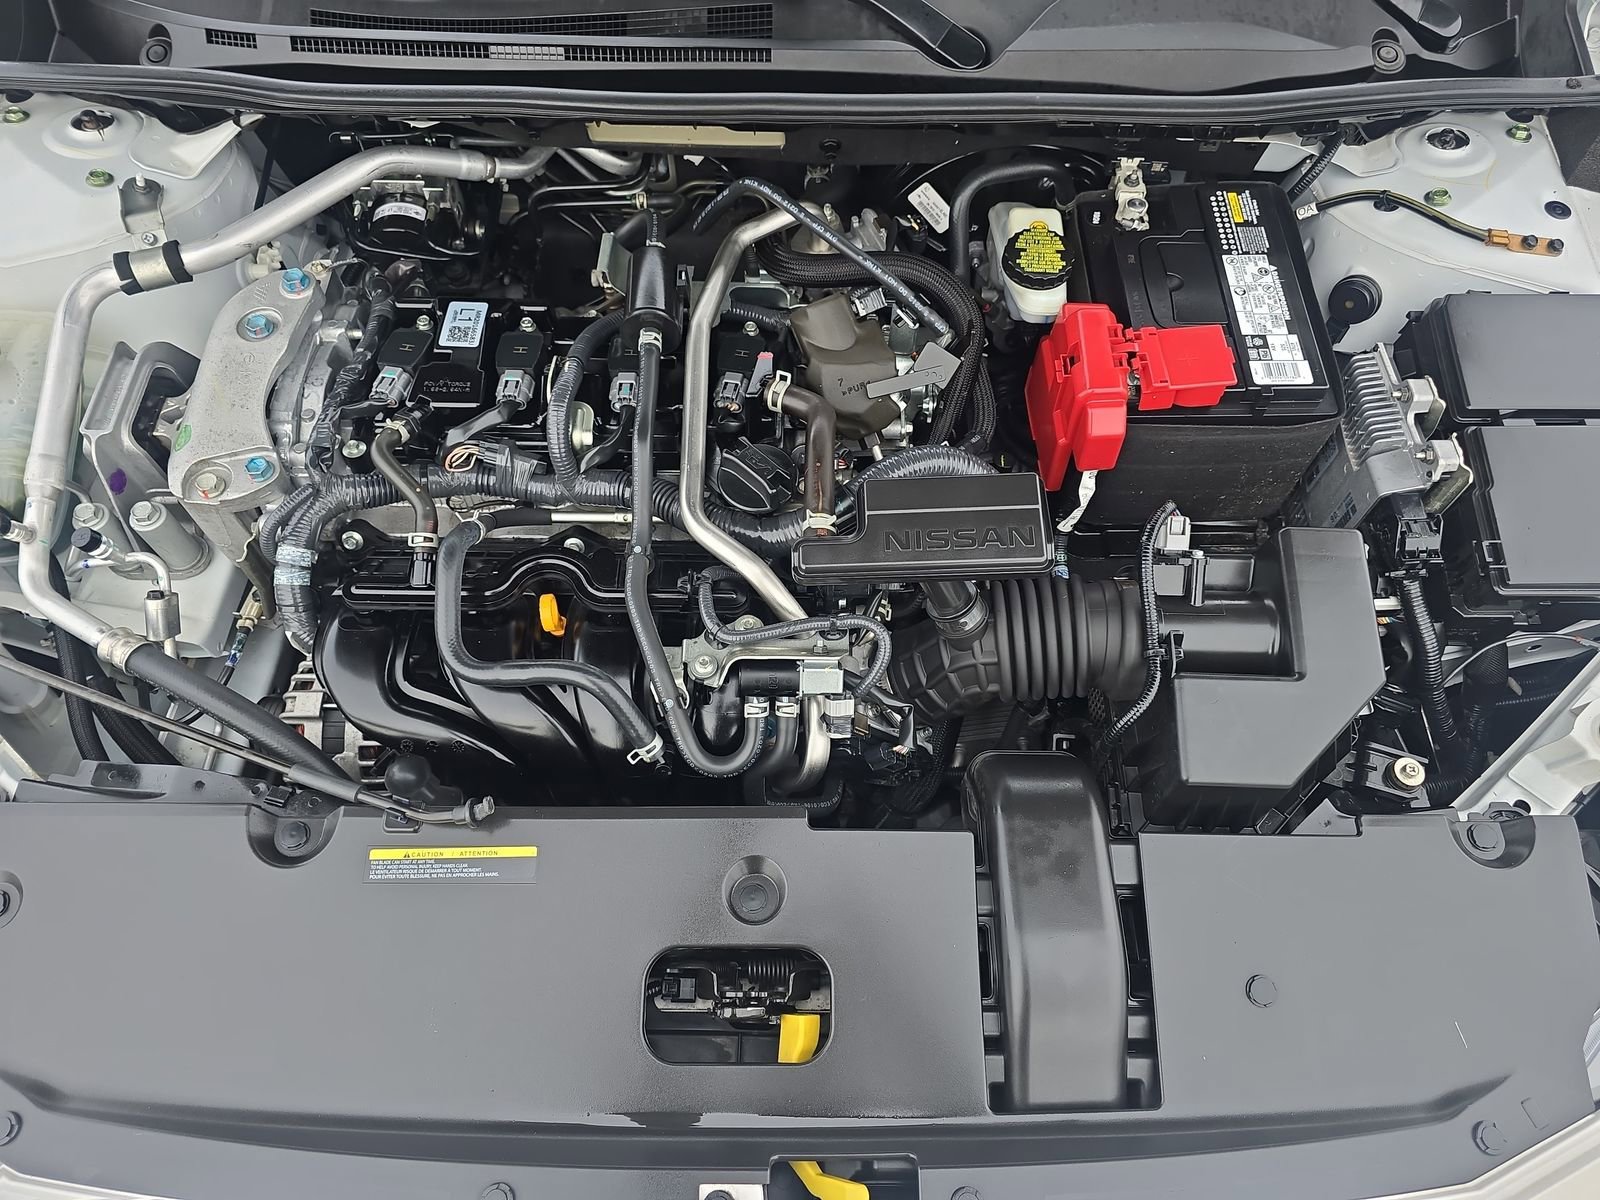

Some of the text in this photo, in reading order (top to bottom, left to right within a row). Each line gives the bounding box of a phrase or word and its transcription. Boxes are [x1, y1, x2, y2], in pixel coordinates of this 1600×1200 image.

[458, 308, 476, 322] L1
[1260, 349, 1269, 359] Pb
[884, 526, 1036, 552] NISSAN
